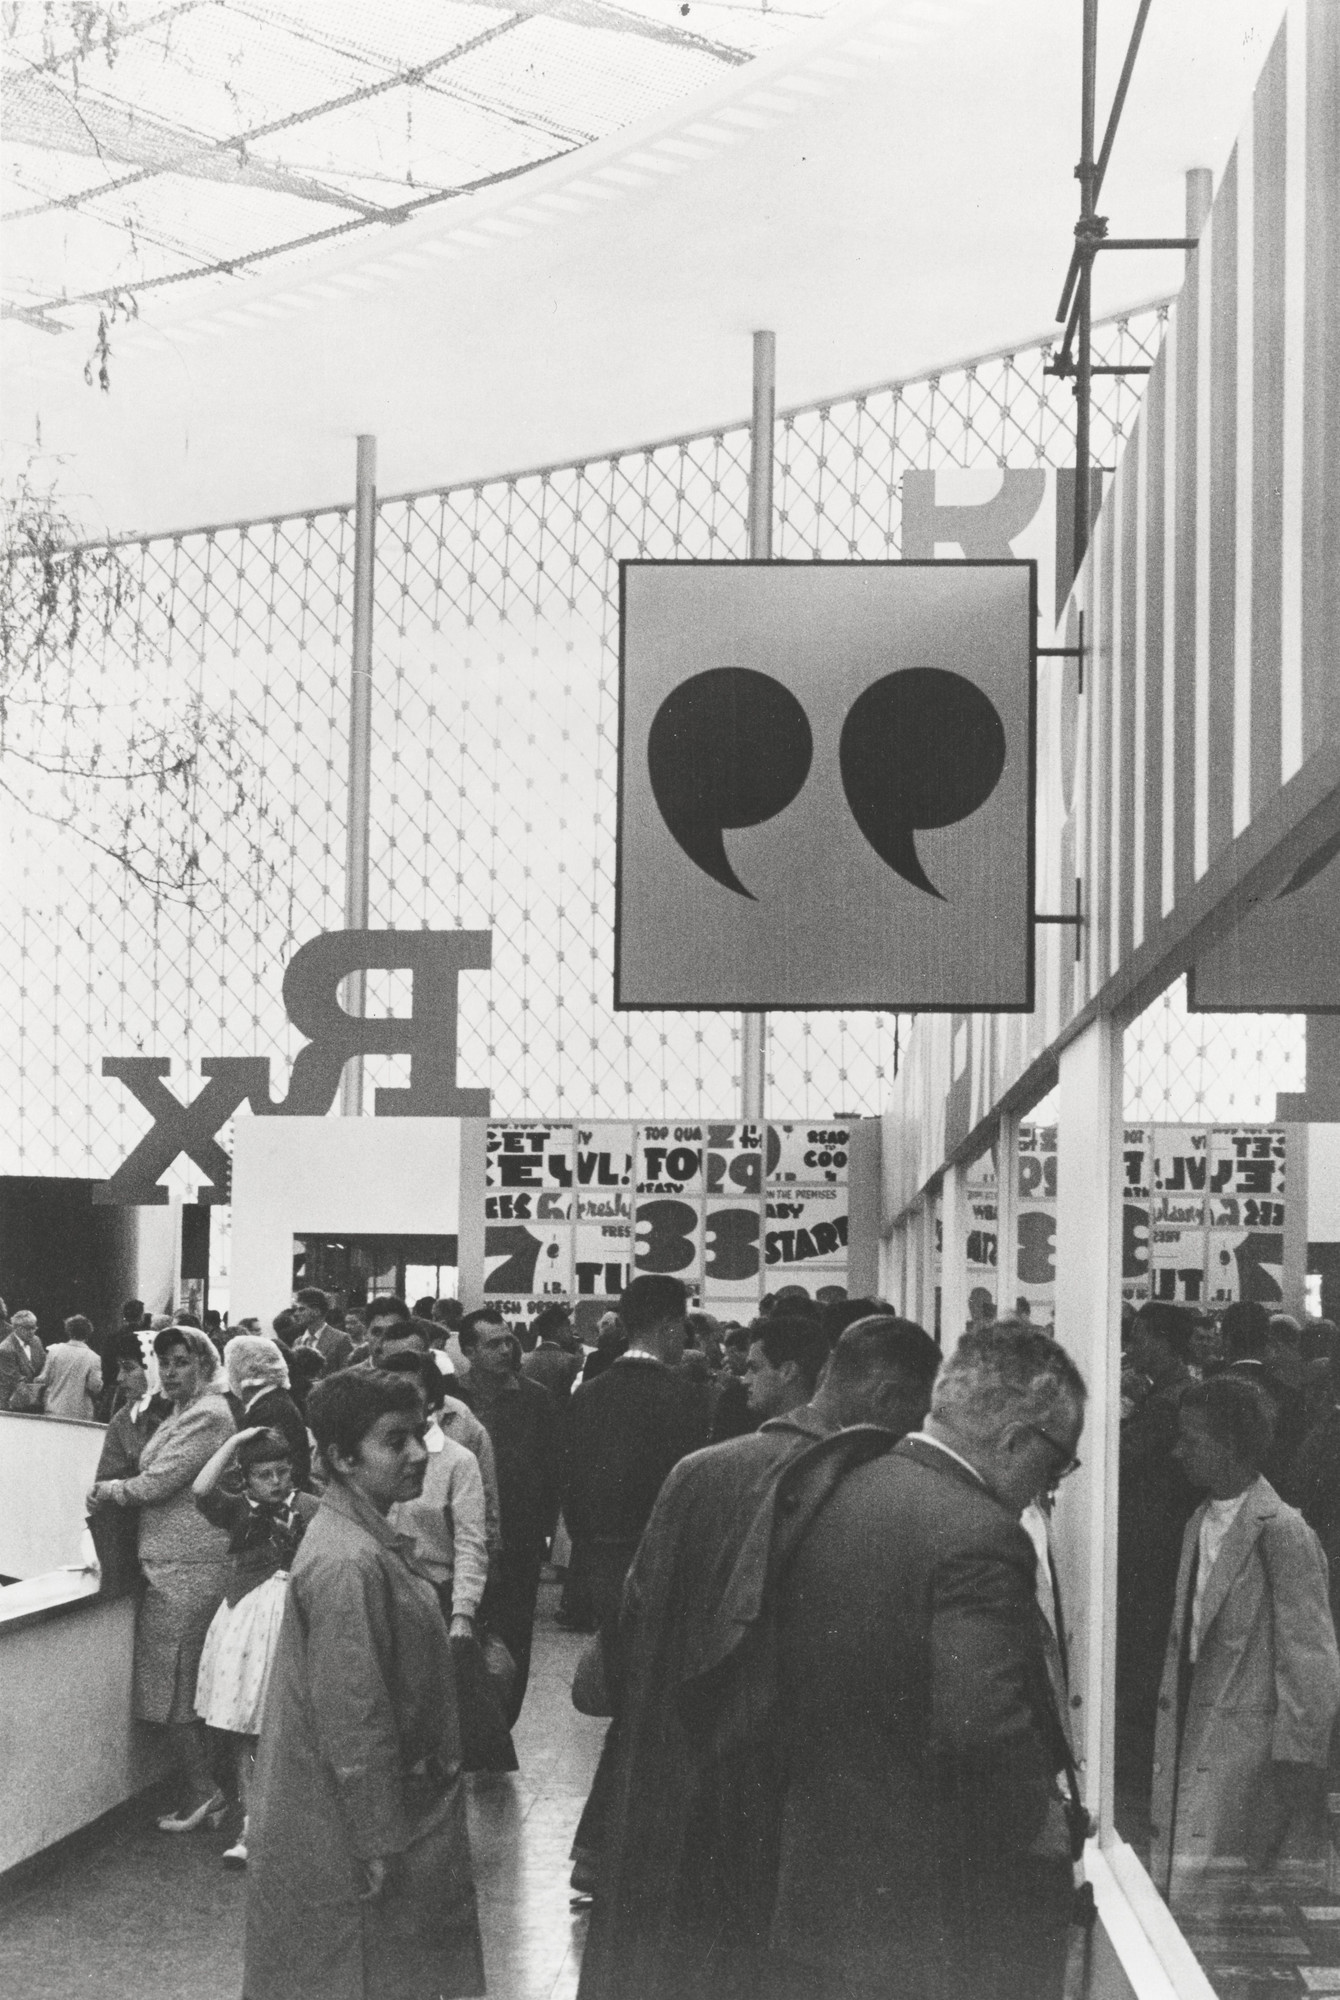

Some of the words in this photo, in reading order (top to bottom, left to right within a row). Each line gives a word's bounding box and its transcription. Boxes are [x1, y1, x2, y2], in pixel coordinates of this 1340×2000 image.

[644, 1126, 669, 1141] TOP
[643, 1147, 702, 1182] FO
[795, 1189, 837, 1200] PREMISES
